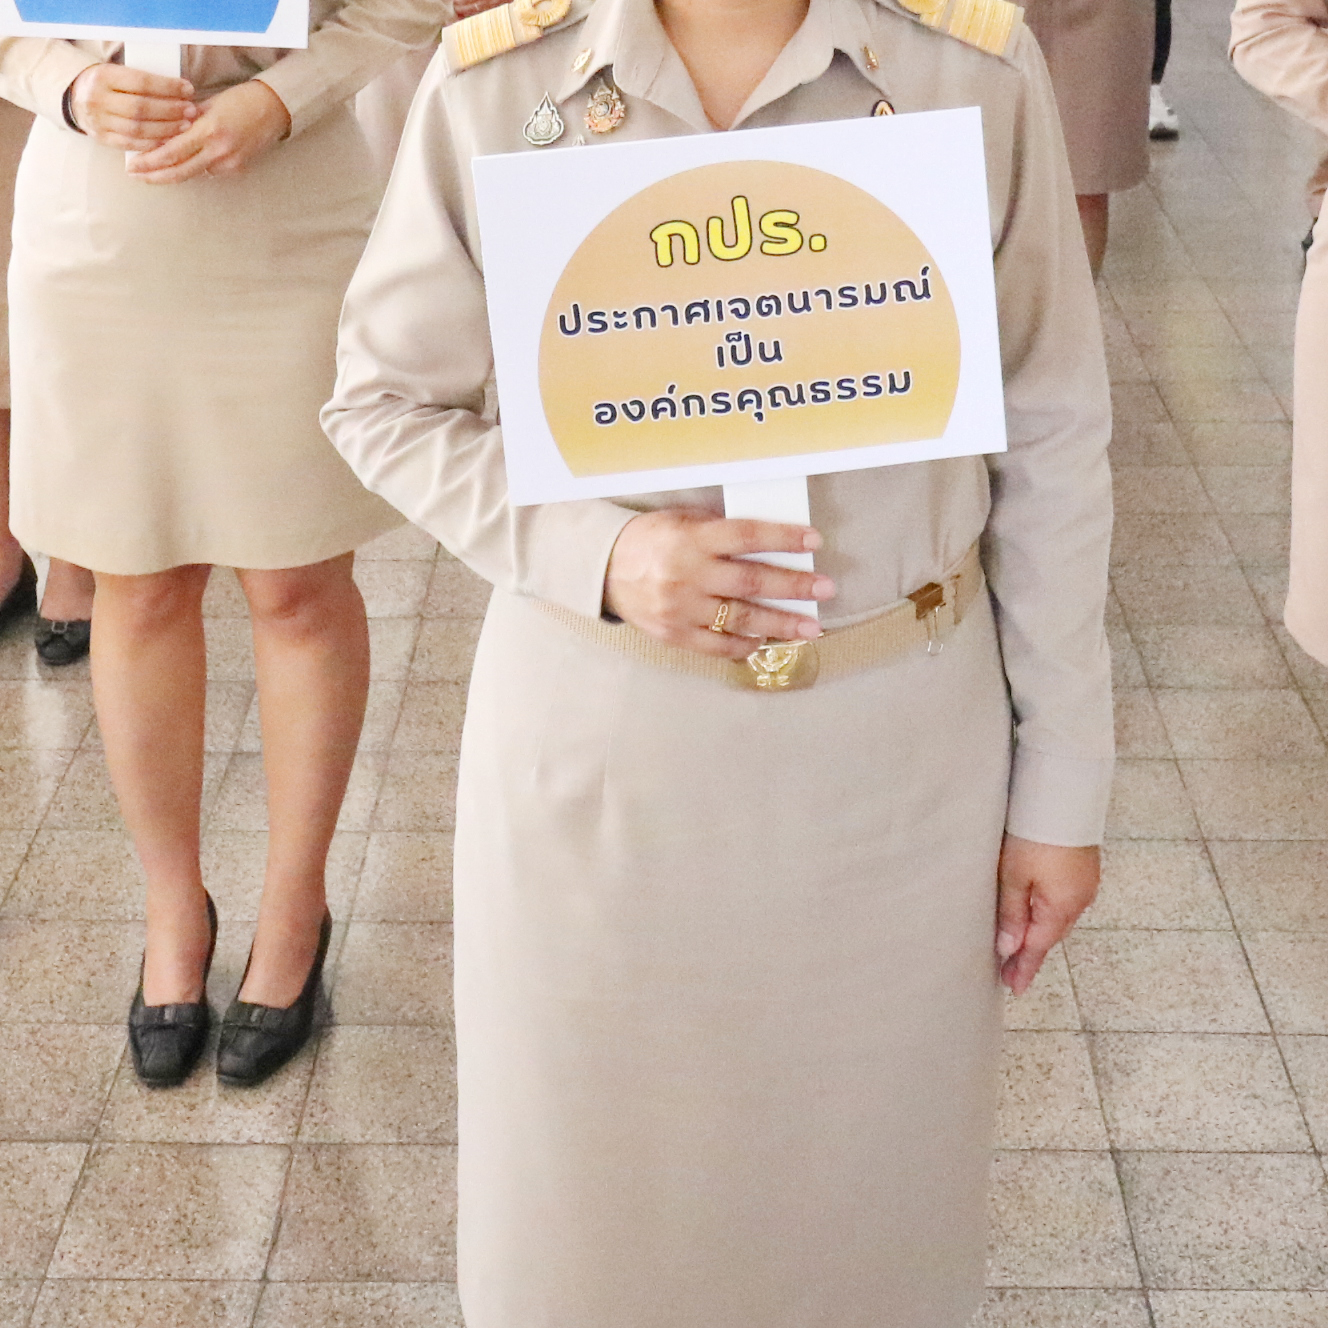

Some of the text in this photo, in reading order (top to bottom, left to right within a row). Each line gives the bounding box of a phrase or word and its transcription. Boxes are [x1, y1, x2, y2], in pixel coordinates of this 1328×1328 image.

[648, 194, 829, 268] กปร.
[557, 264, 934, 338] ประกาศเจตนารมณ์
[715, 332, 785, 369] เป็น
[592, 366, 914, 428] องค์กรคุณธรรม
